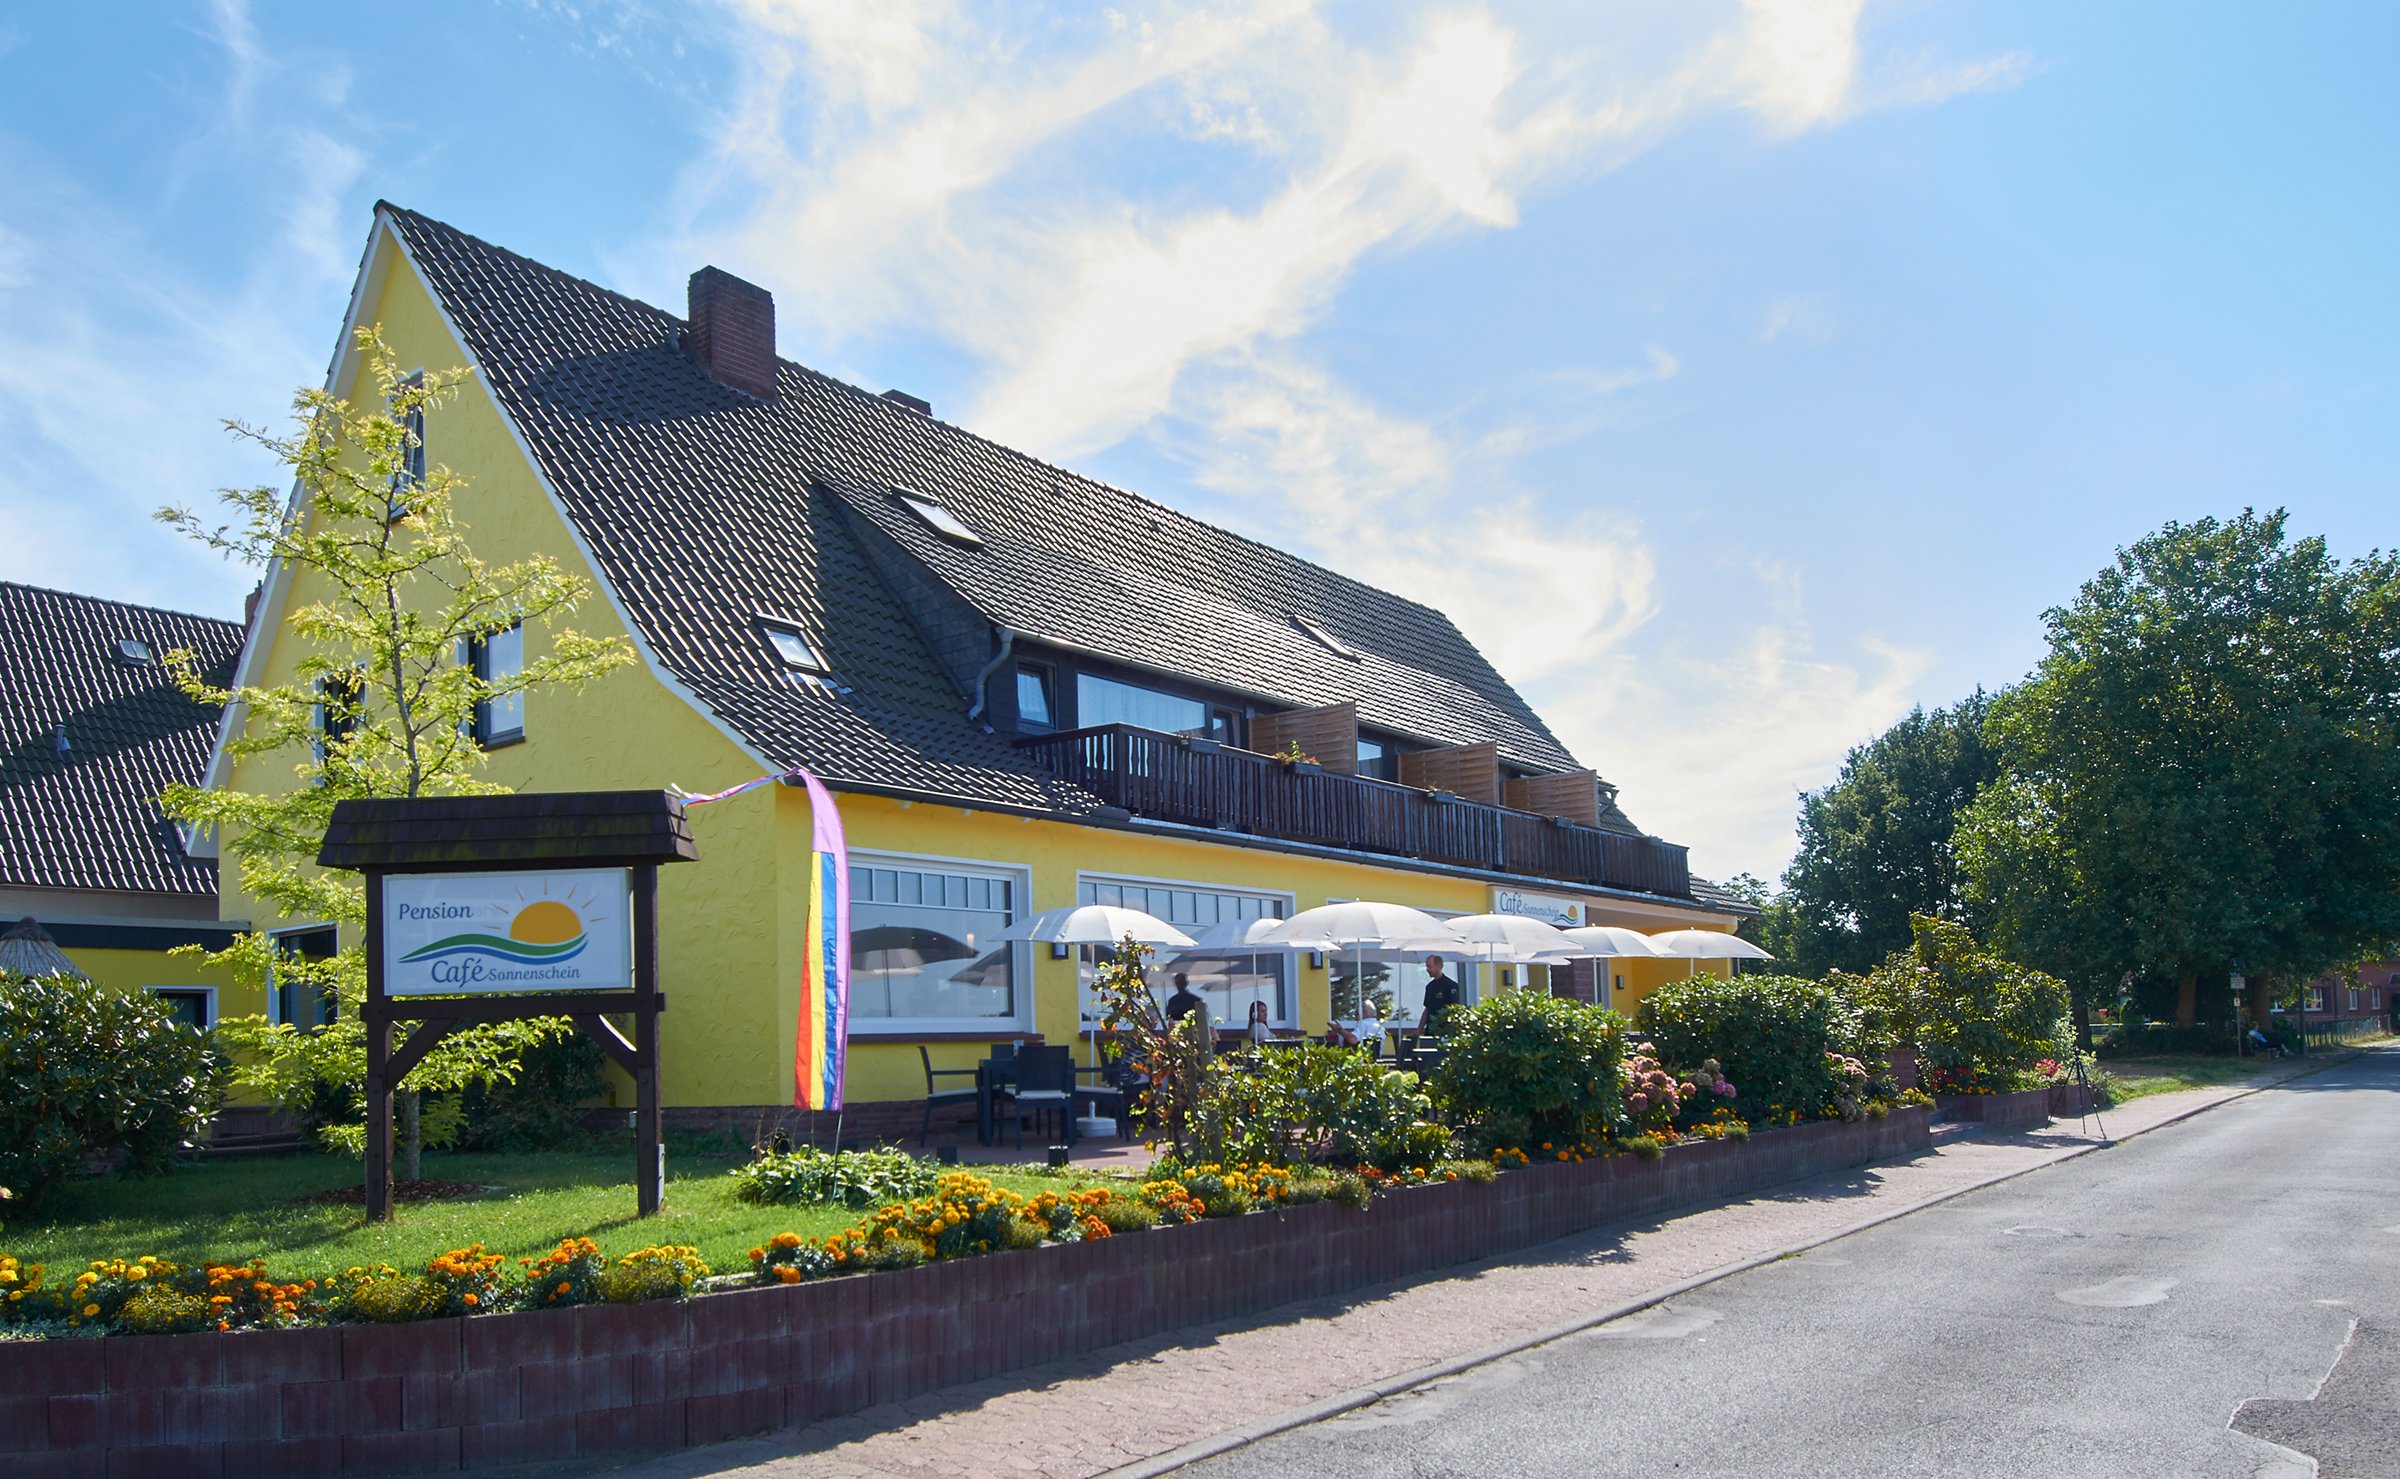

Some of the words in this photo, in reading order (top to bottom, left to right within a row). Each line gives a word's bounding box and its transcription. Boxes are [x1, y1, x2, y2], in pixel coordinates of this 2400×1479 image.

[399, 902, 473, 920] Pension
[1500, 892, 1523, 915] Café
[431, 958, 489, 988] Café
[489, 965, 580, 981] Sonnenschein
